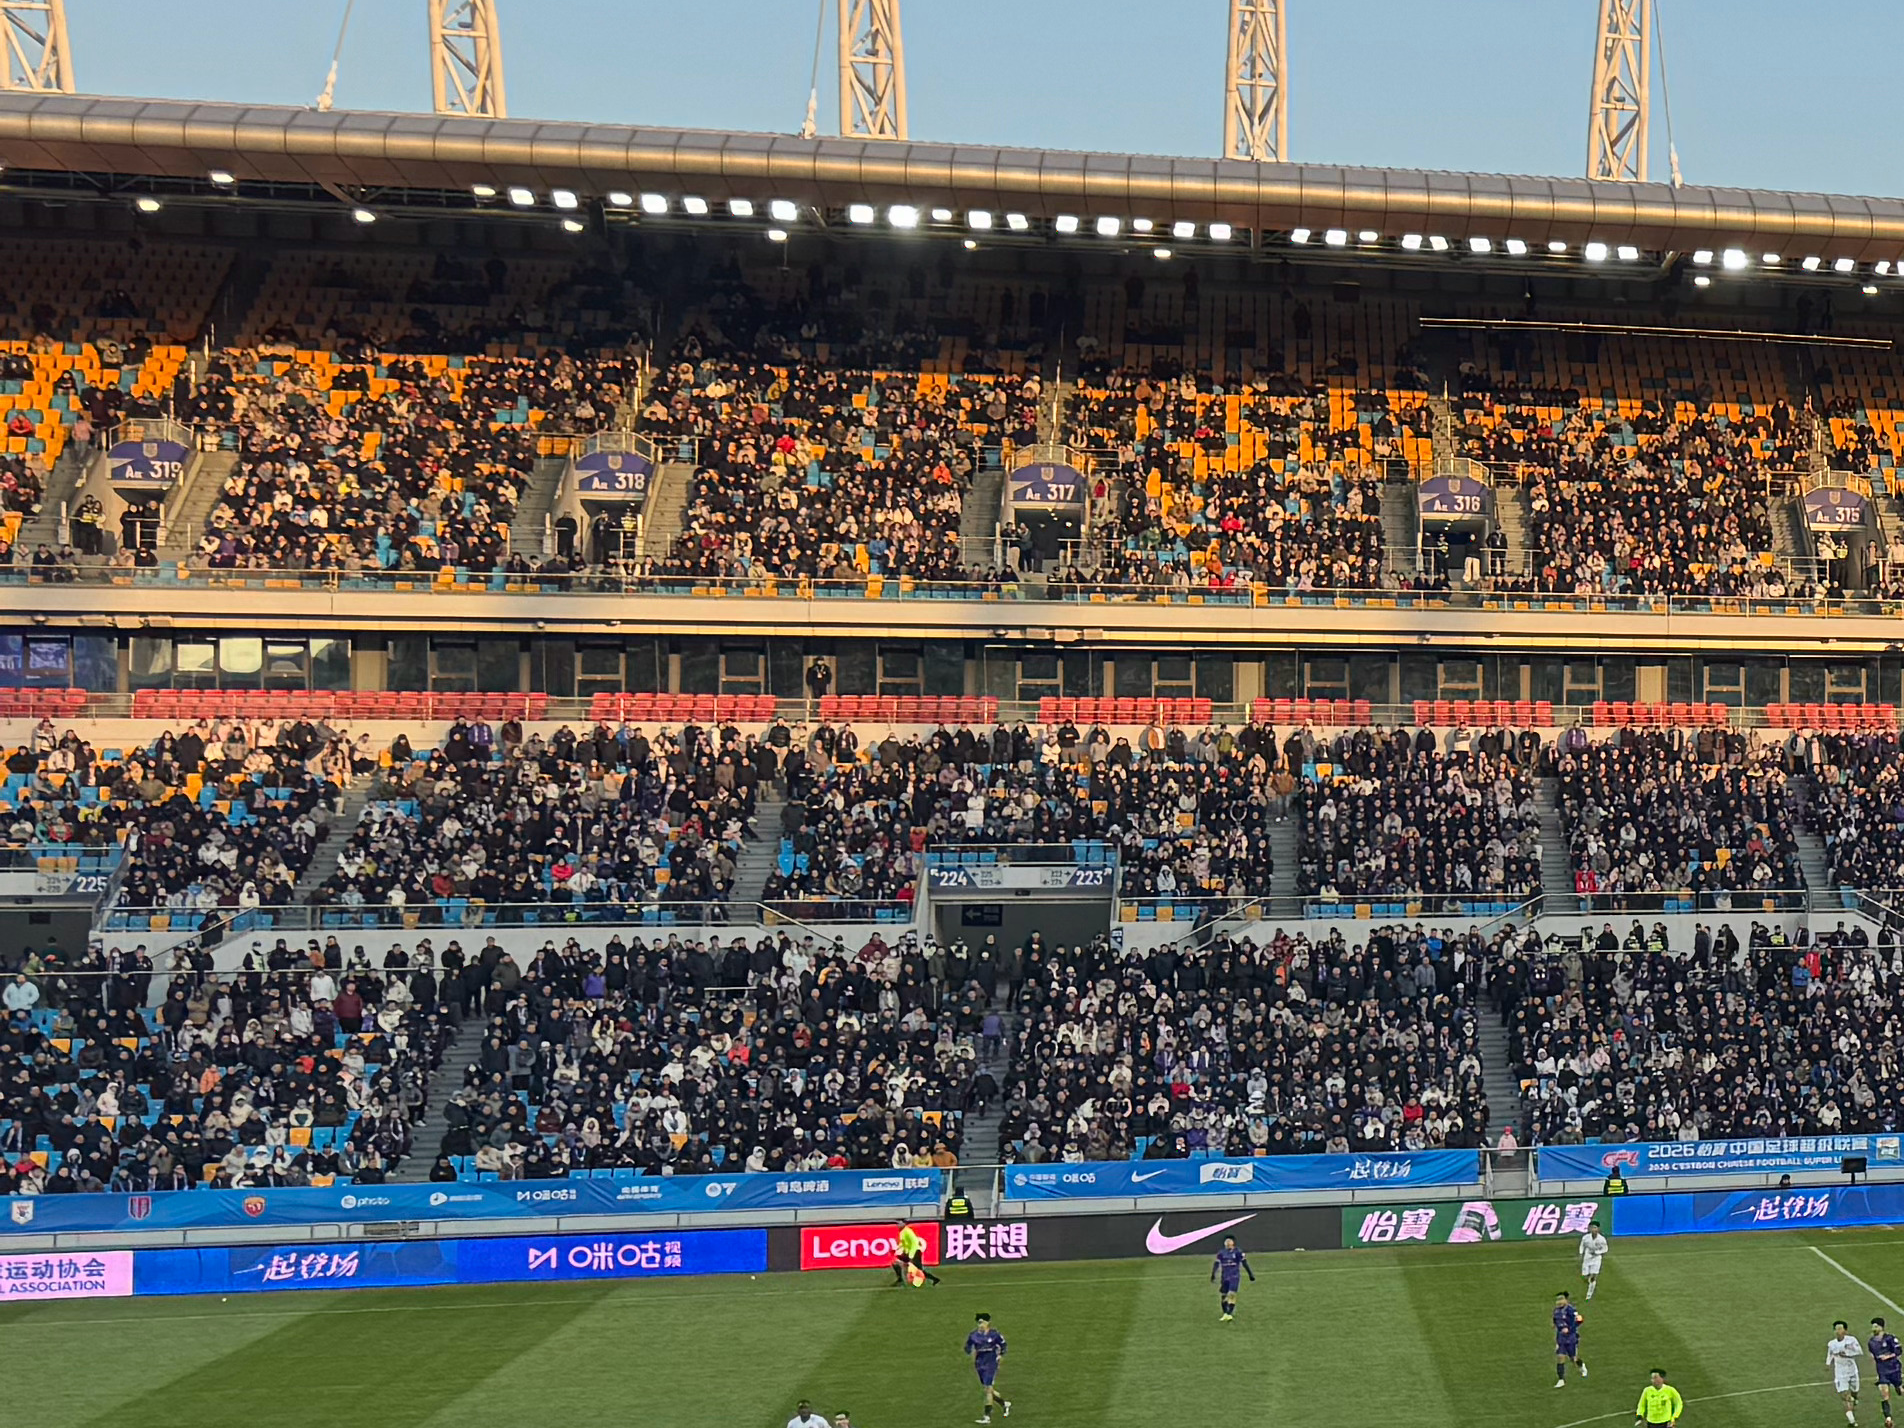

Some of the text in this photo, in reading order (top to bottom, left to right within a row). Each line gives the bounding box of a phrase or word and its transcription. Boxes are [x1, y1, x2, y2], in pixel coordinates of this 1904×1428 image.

[615, 472, 645, 490] 318
[1047, 483, 1075, 501] 317
[1454, 495, 1481, 511] 316
[1835, 506, 1860, 522] 315
[77, 876, 108, 892] 225
[939, 871, 968, 886] 224
[1076, 870, 1102, 886] 223
[1648, 1143, 1695, 1158] 2026
[1729, 1137, 1868, 1155] 中国足球超级联赛
[1649, 1162, 1670, 1171] 2026
[1672, 1161, 1715, 1170] C'ESTBON
[1717, 1159, 1754, 1168] CHINESE
[1756, 1155, 1802, 1167] FOOTBALL
[1803, 1155, 1833, 1165] SUPER
[357, 1197, 390, 1207] photo
[1730, 1193, 1830, 1223] 一起登场
[945, 1222, 1029, 1260] 联想
[664, 1241, 682, 1268] 视频
[0, 1257, 106, 1280] 运动协会
[233, 1250, 360, 1283] 一起登场
[9, 1280, 106, 1293] ASSOCIATION
